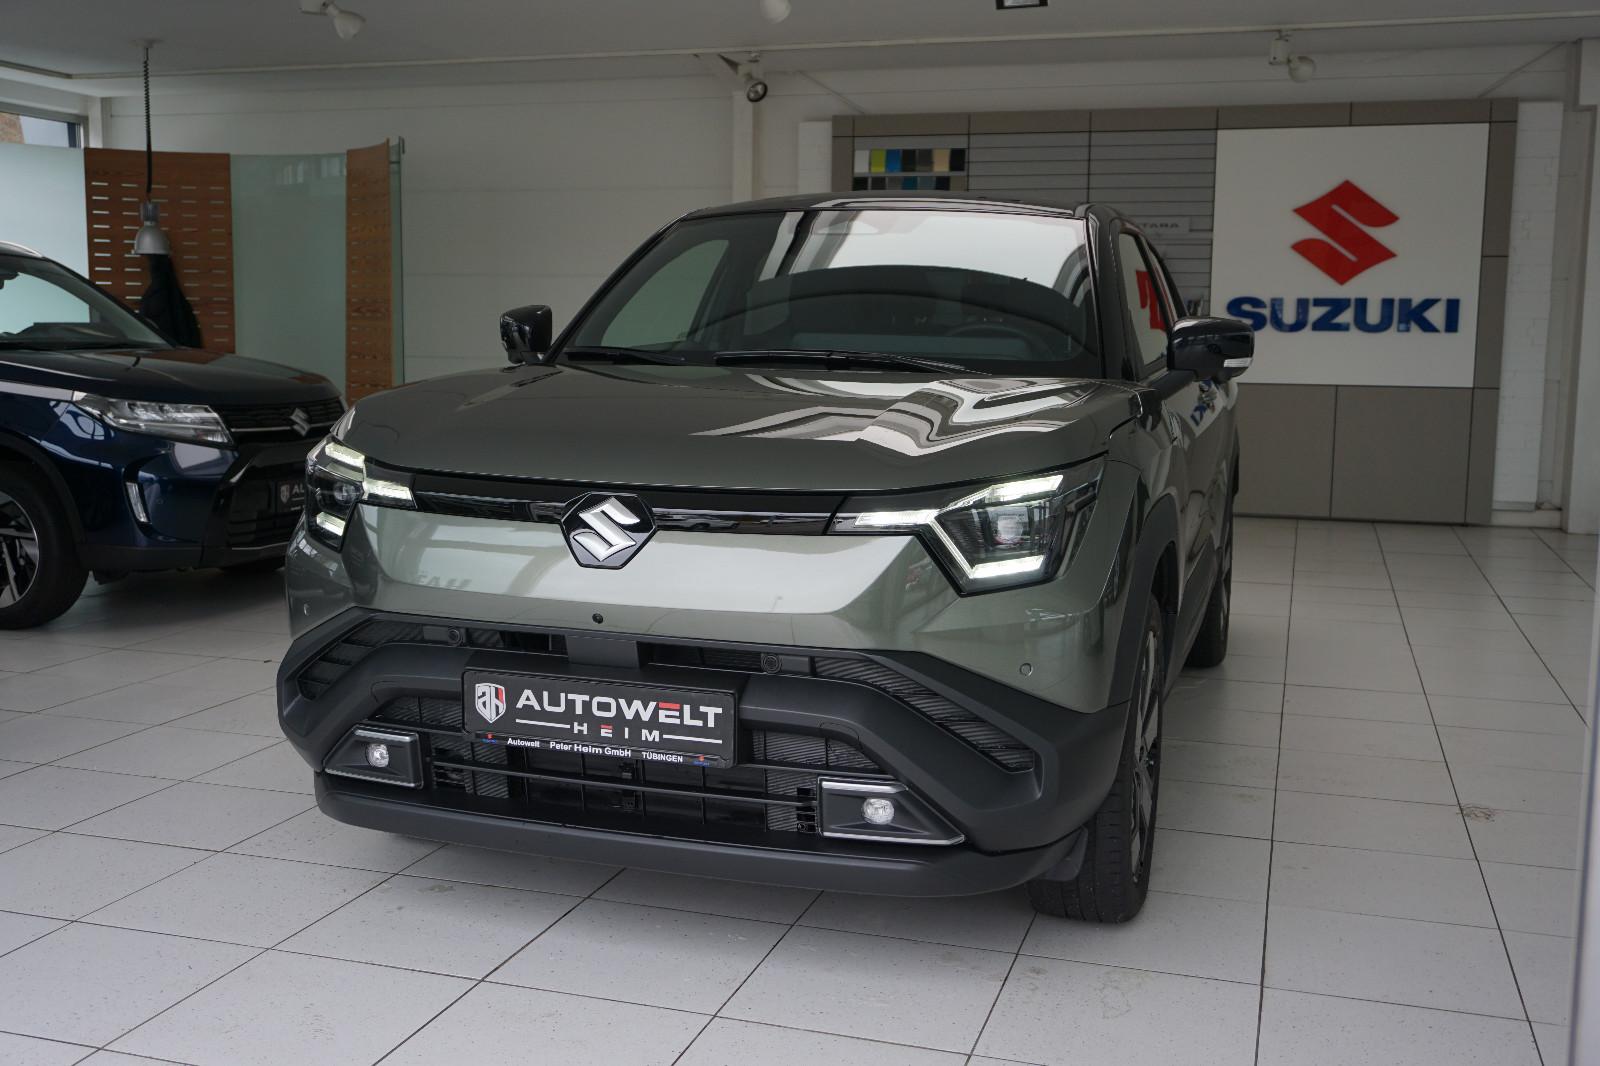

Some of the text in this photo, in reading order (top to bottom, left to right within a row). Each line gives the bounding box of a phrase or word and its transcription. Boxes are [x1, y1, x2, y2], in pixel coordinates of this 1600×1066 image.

[1226, 296, 1460, 333] SUZUKI
[516, 689, 723, 728] AUTOWELT
[574, 722, 660, 742] HEIM
[507, 738, 540, 748] Autowelt
[550, 741, 572, 751] Peter
[574, 743, 603, 754] Heim
[604, 747, 631, 758] GmbH
[641, 751, 683, 763] TÜBINGEN
